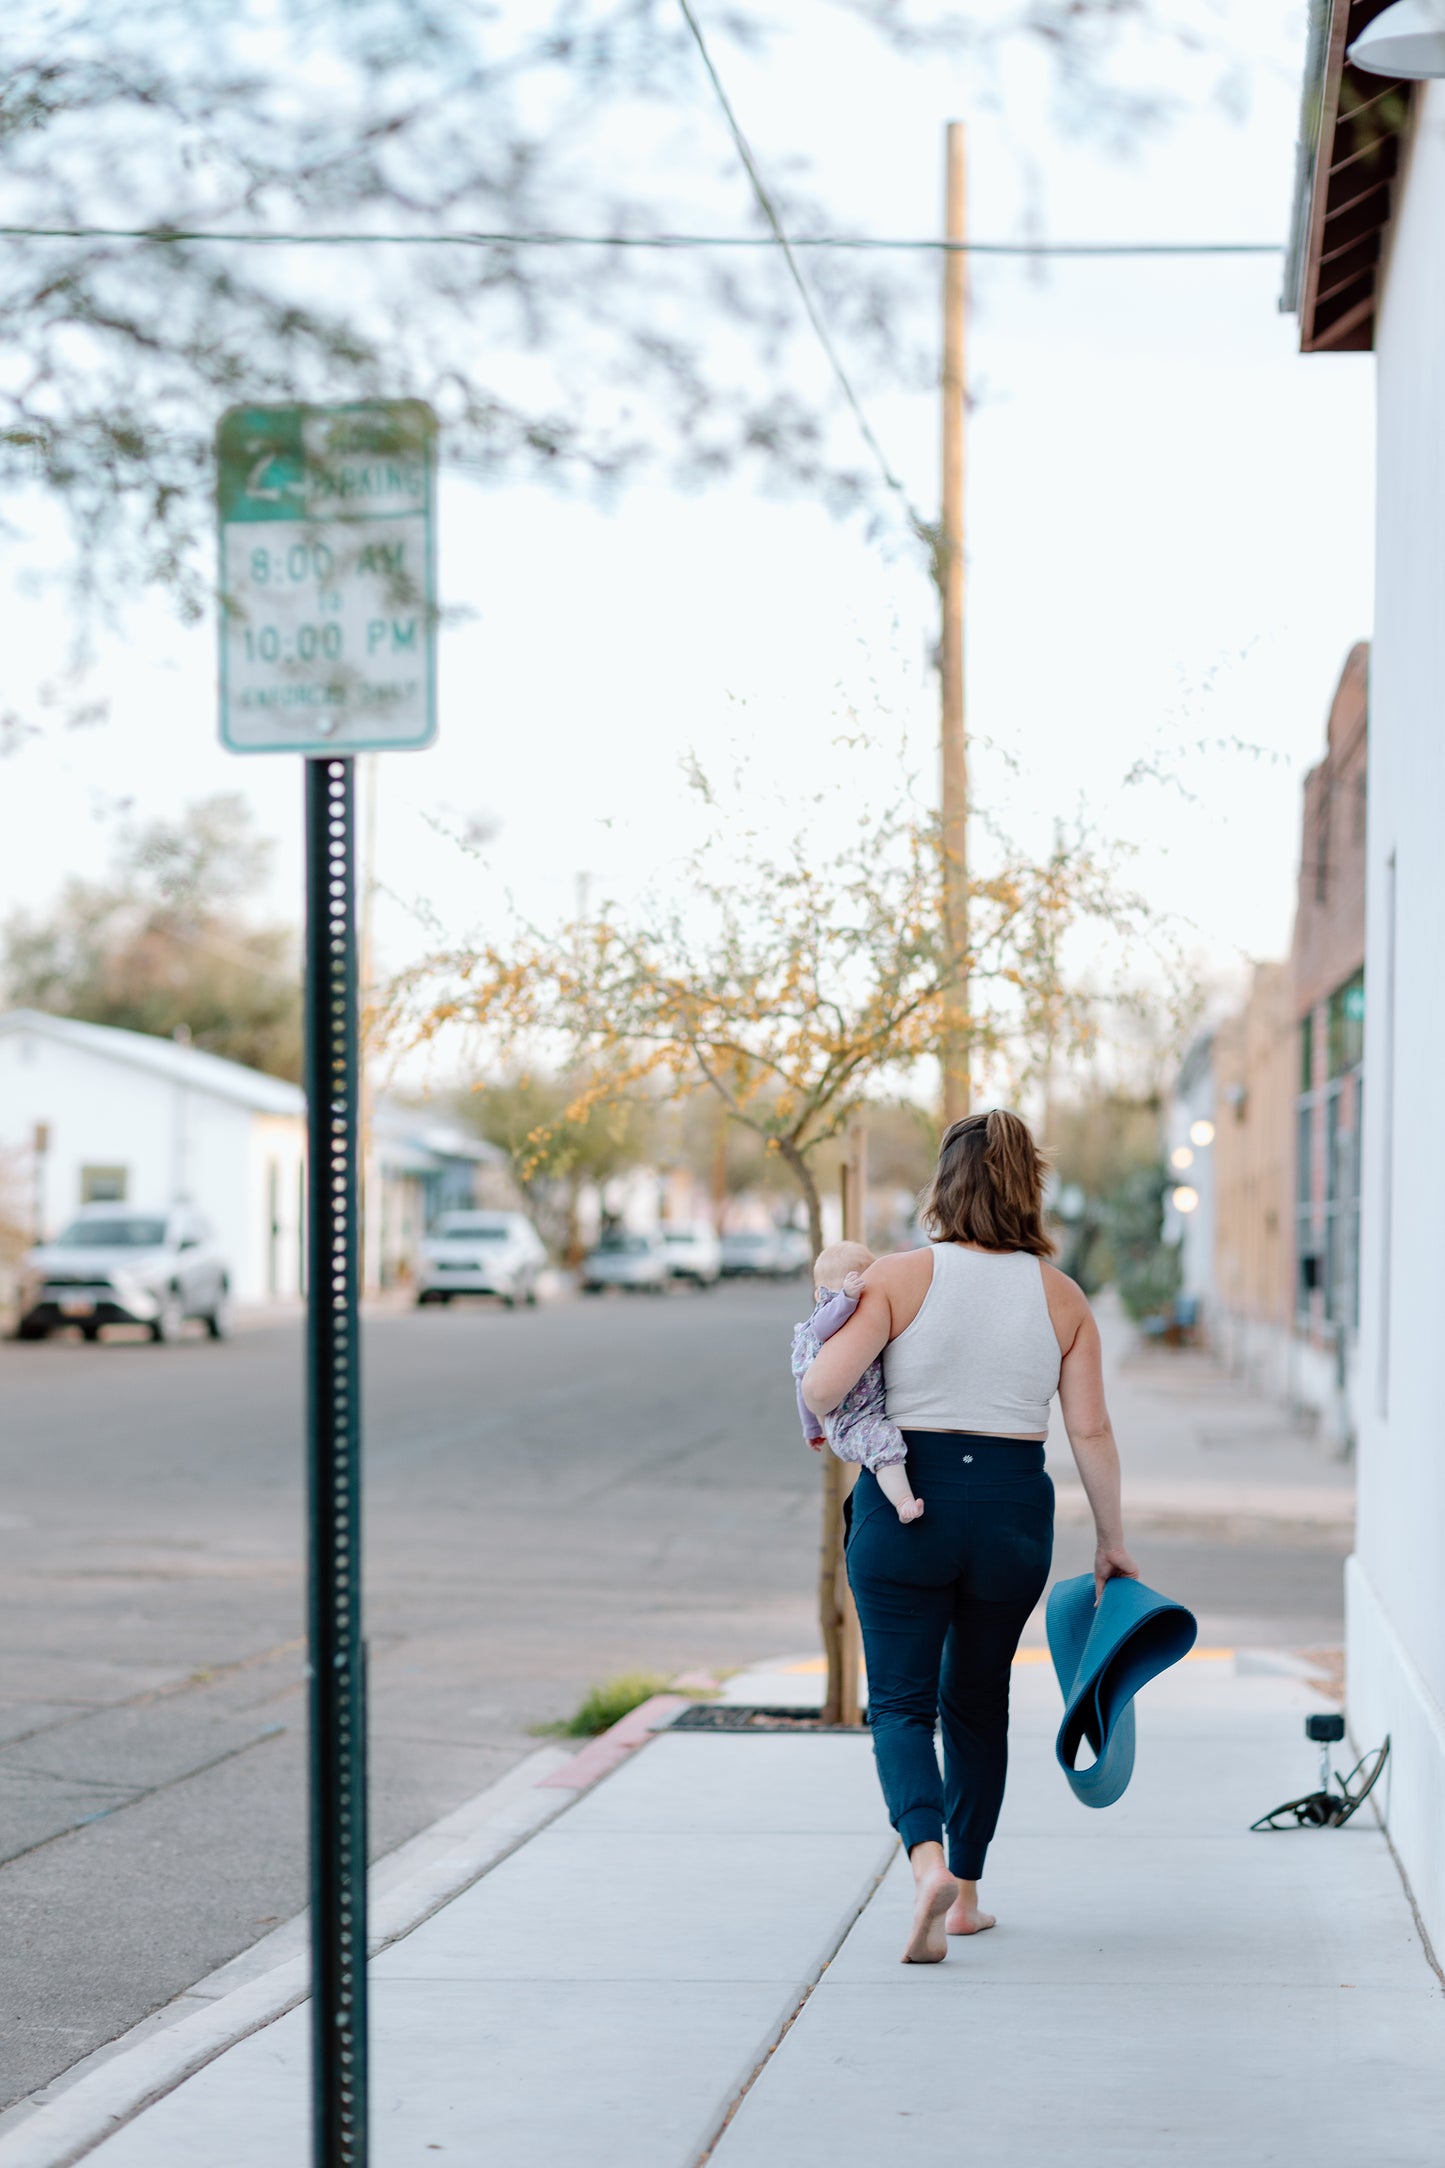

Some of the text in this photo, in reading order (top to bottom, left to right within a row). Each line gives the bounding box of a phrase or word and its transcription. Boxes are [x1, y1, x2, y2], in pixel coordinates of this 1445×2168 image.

[251, 543, 334, 584] 8:00
[244, 617, 417, 663] 10:00 PM
